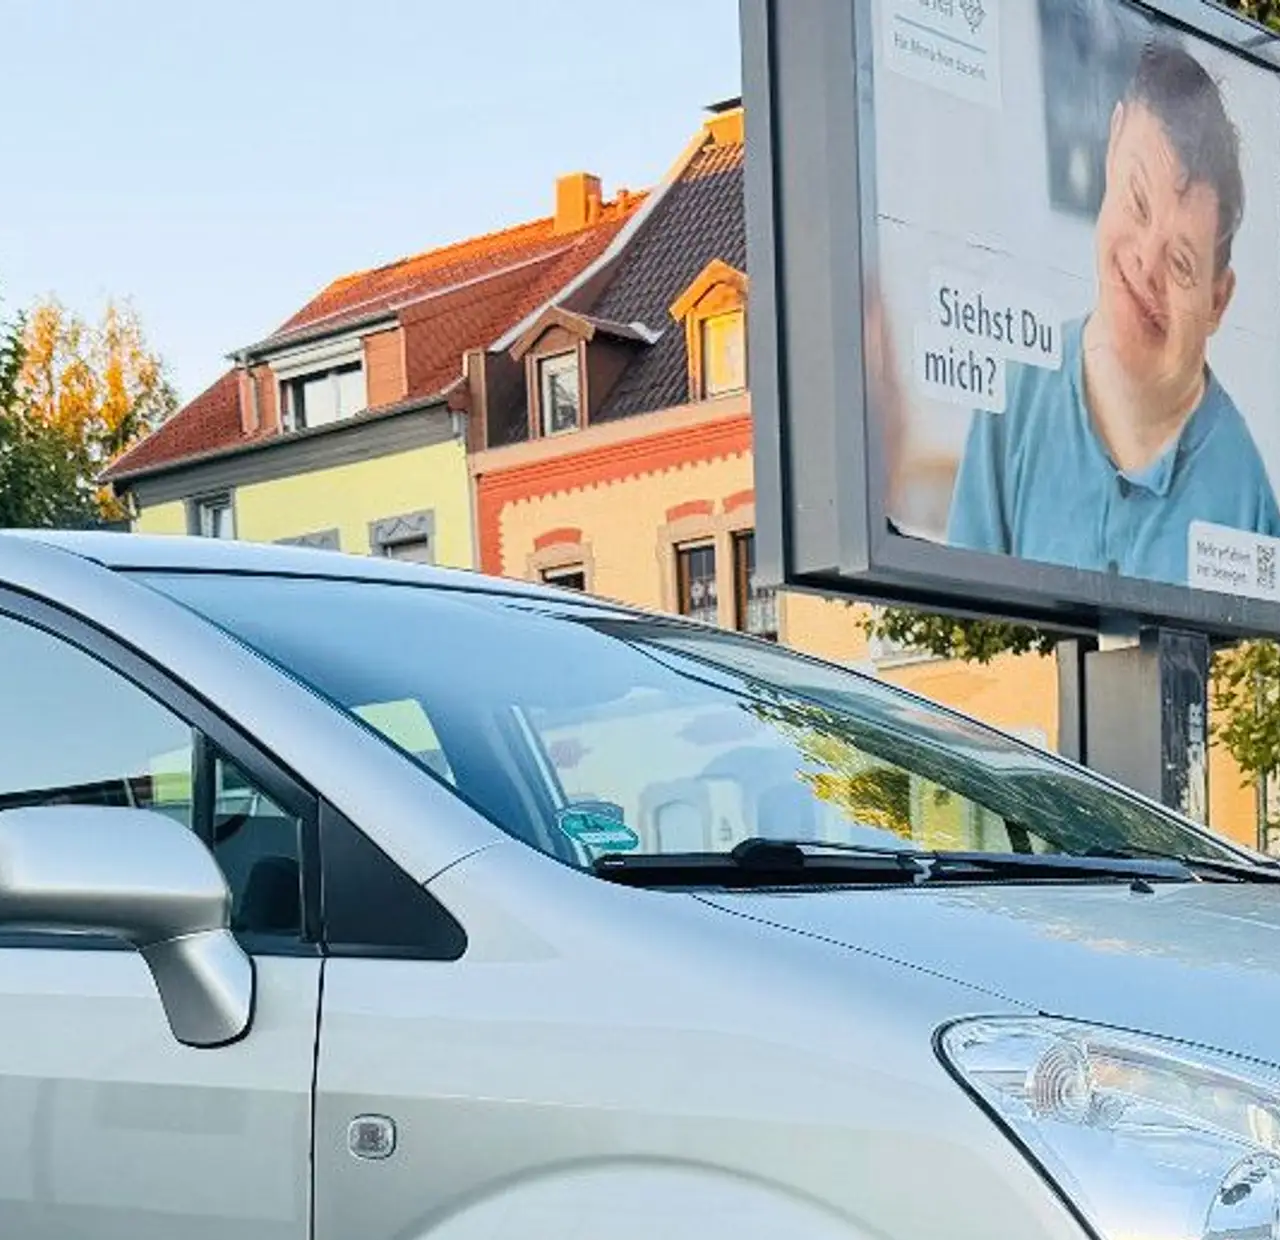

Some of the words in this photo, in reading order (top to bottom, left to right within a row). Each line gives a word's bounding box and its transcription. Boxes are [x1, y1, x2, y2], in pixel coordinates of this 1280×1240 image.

[939, 286, 1014, 344] Siehst
[1022, 309, 1052, 353] Du
[925, 346, 996, 396] mich?
